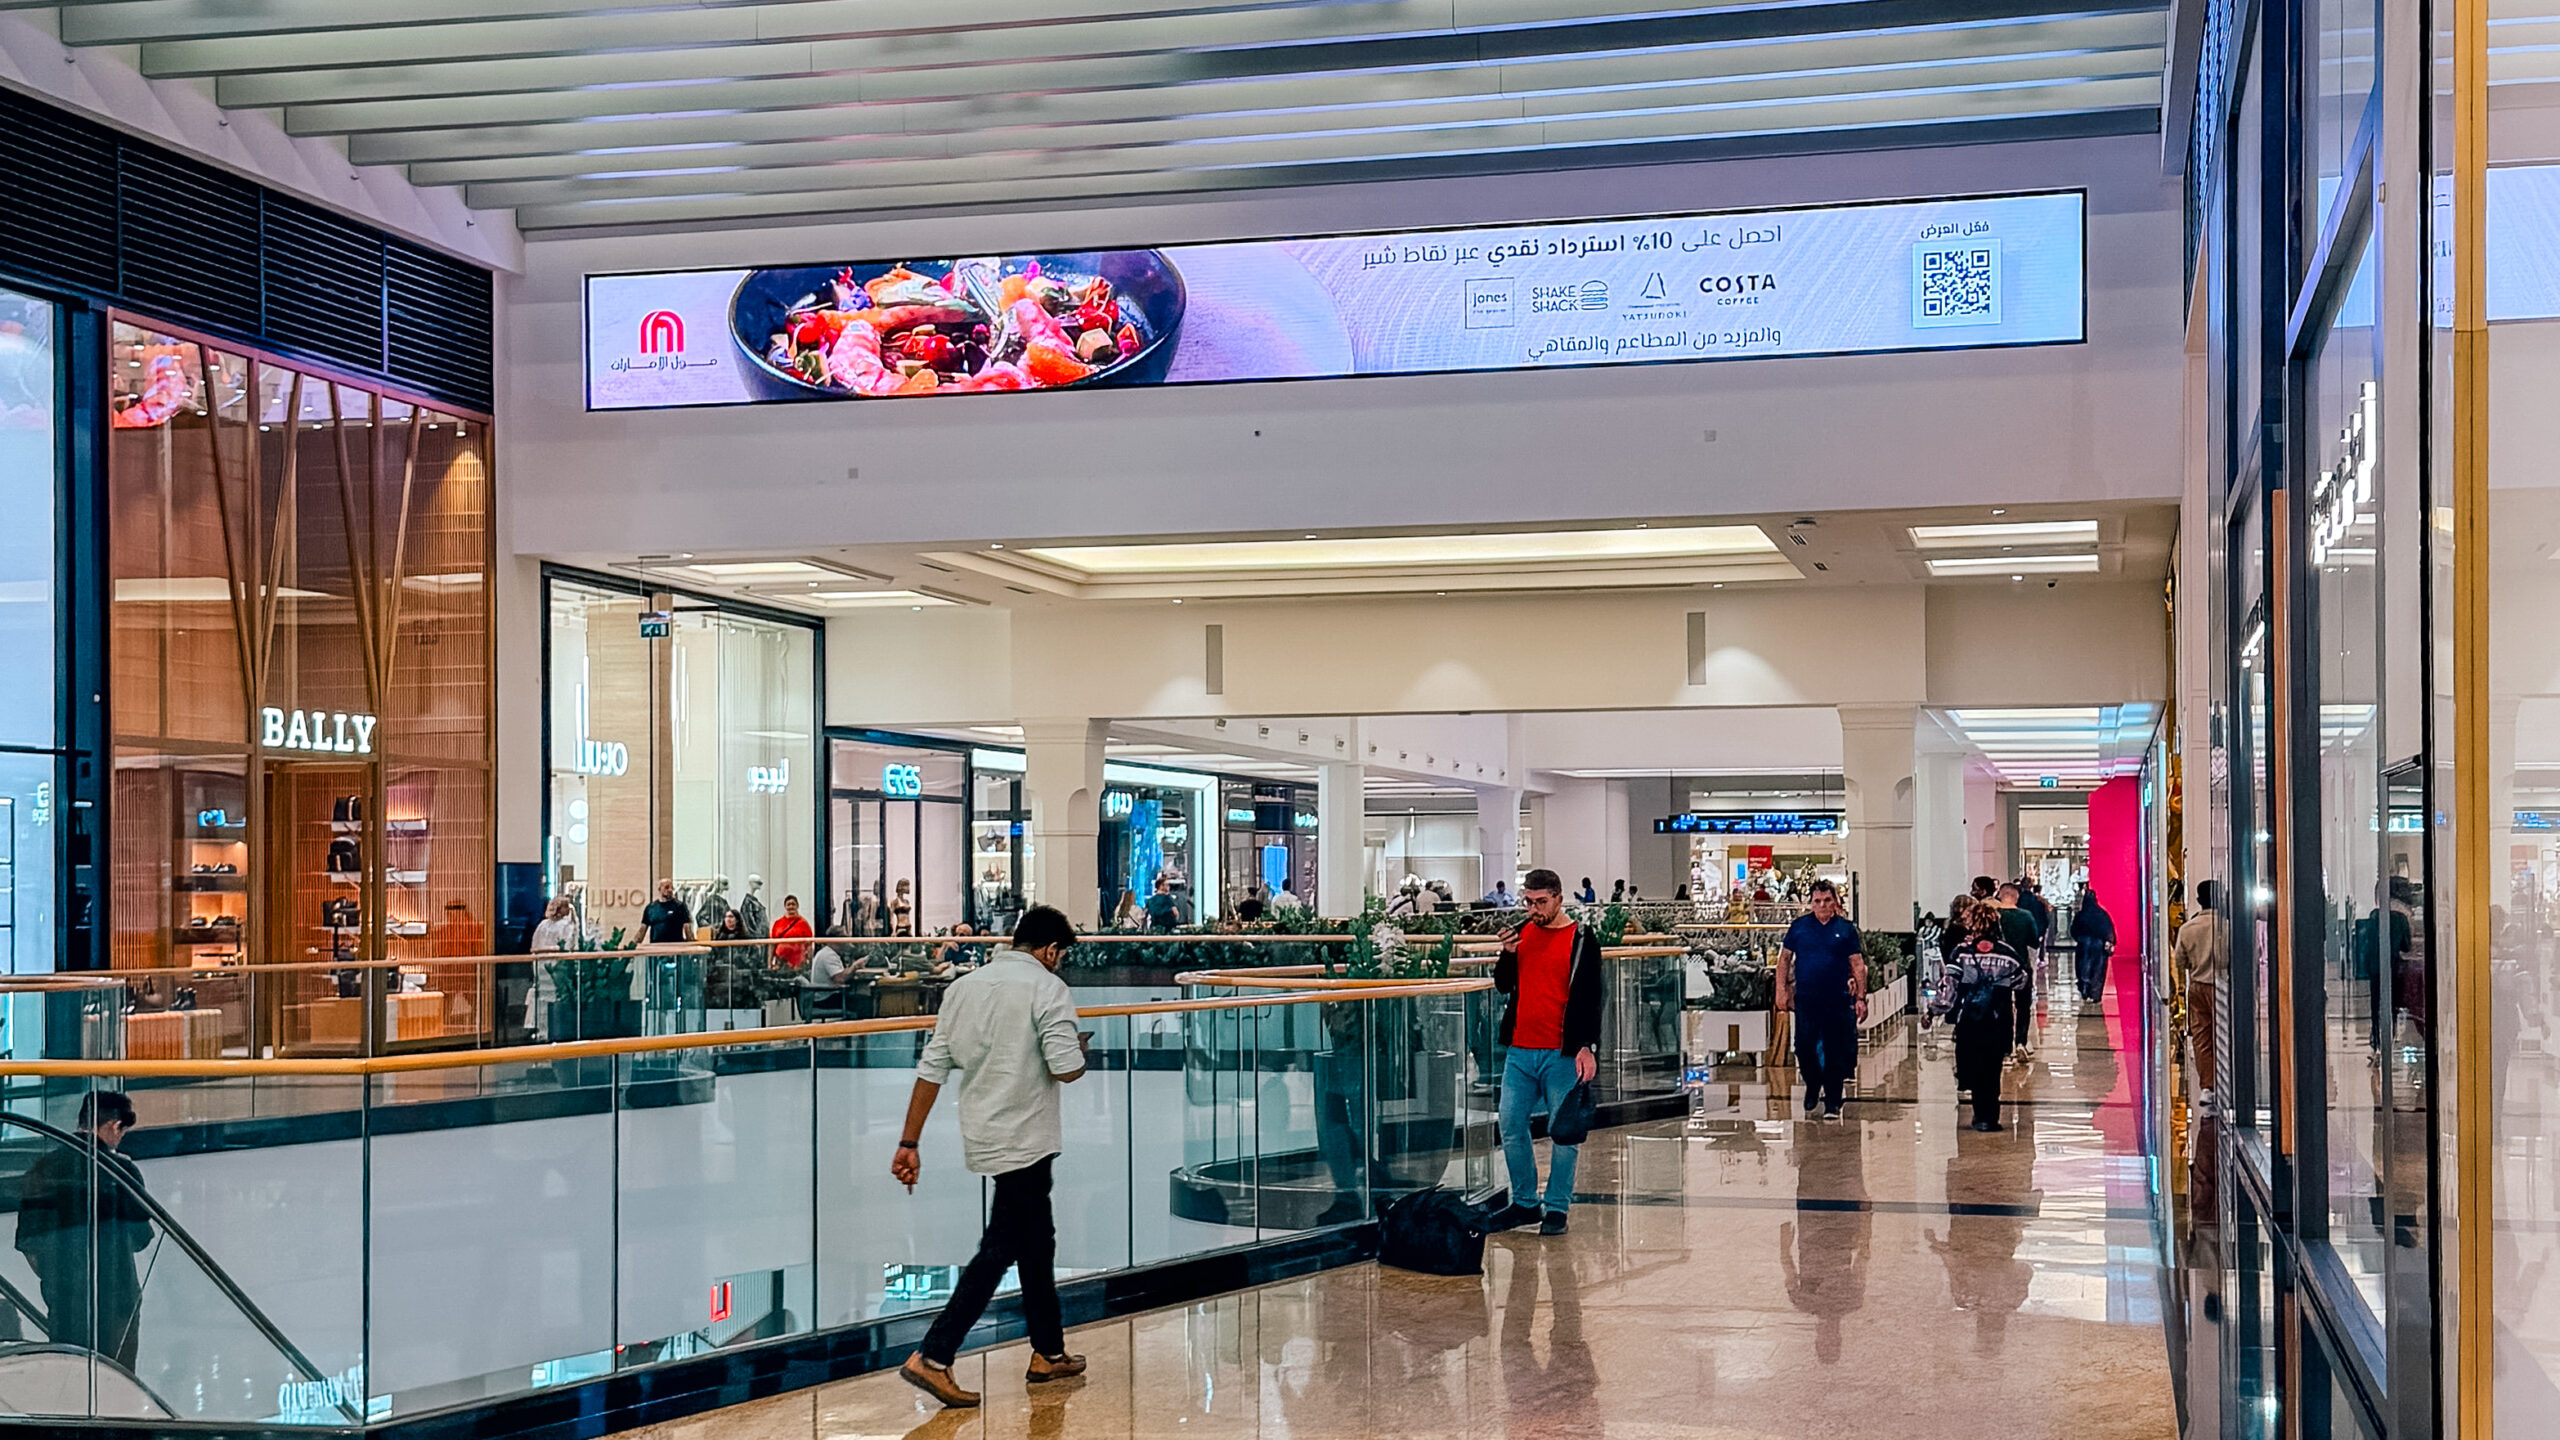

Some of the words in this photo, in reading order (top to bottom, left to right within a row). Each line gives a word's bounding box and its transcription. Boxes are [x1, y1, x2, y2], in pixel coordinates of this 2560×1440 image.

[1681, 229, 1721, 252] على
[1729, 225, 1782, 250] احصل
[1920, 222, 1959, 239] العرض
[1403, 244, 1447, 264] نقاط
[1453, 246, 1480, 266] عبر
[1487, 238, 1539, 268] نقدي
[1547, 234, 1625, 258] استرداد
[1361, 245, 1397, 270] شير
[1532, 285, 1576, 299] SHAKE
[1699, 274, 1776, 293] COSTA
[1532, 299, 1579, 313] SHACK
[1717, 296, 1760, 306] COFFEE
[1528, 335, 1609, 361] والمقاهي
[1616, 330, 1687, 355] المطاعم
[1692, 330, 1718, 350] من
[1723, 326, 1782, 348] والمزيد
[261, 706, 377, 754] BALLY
